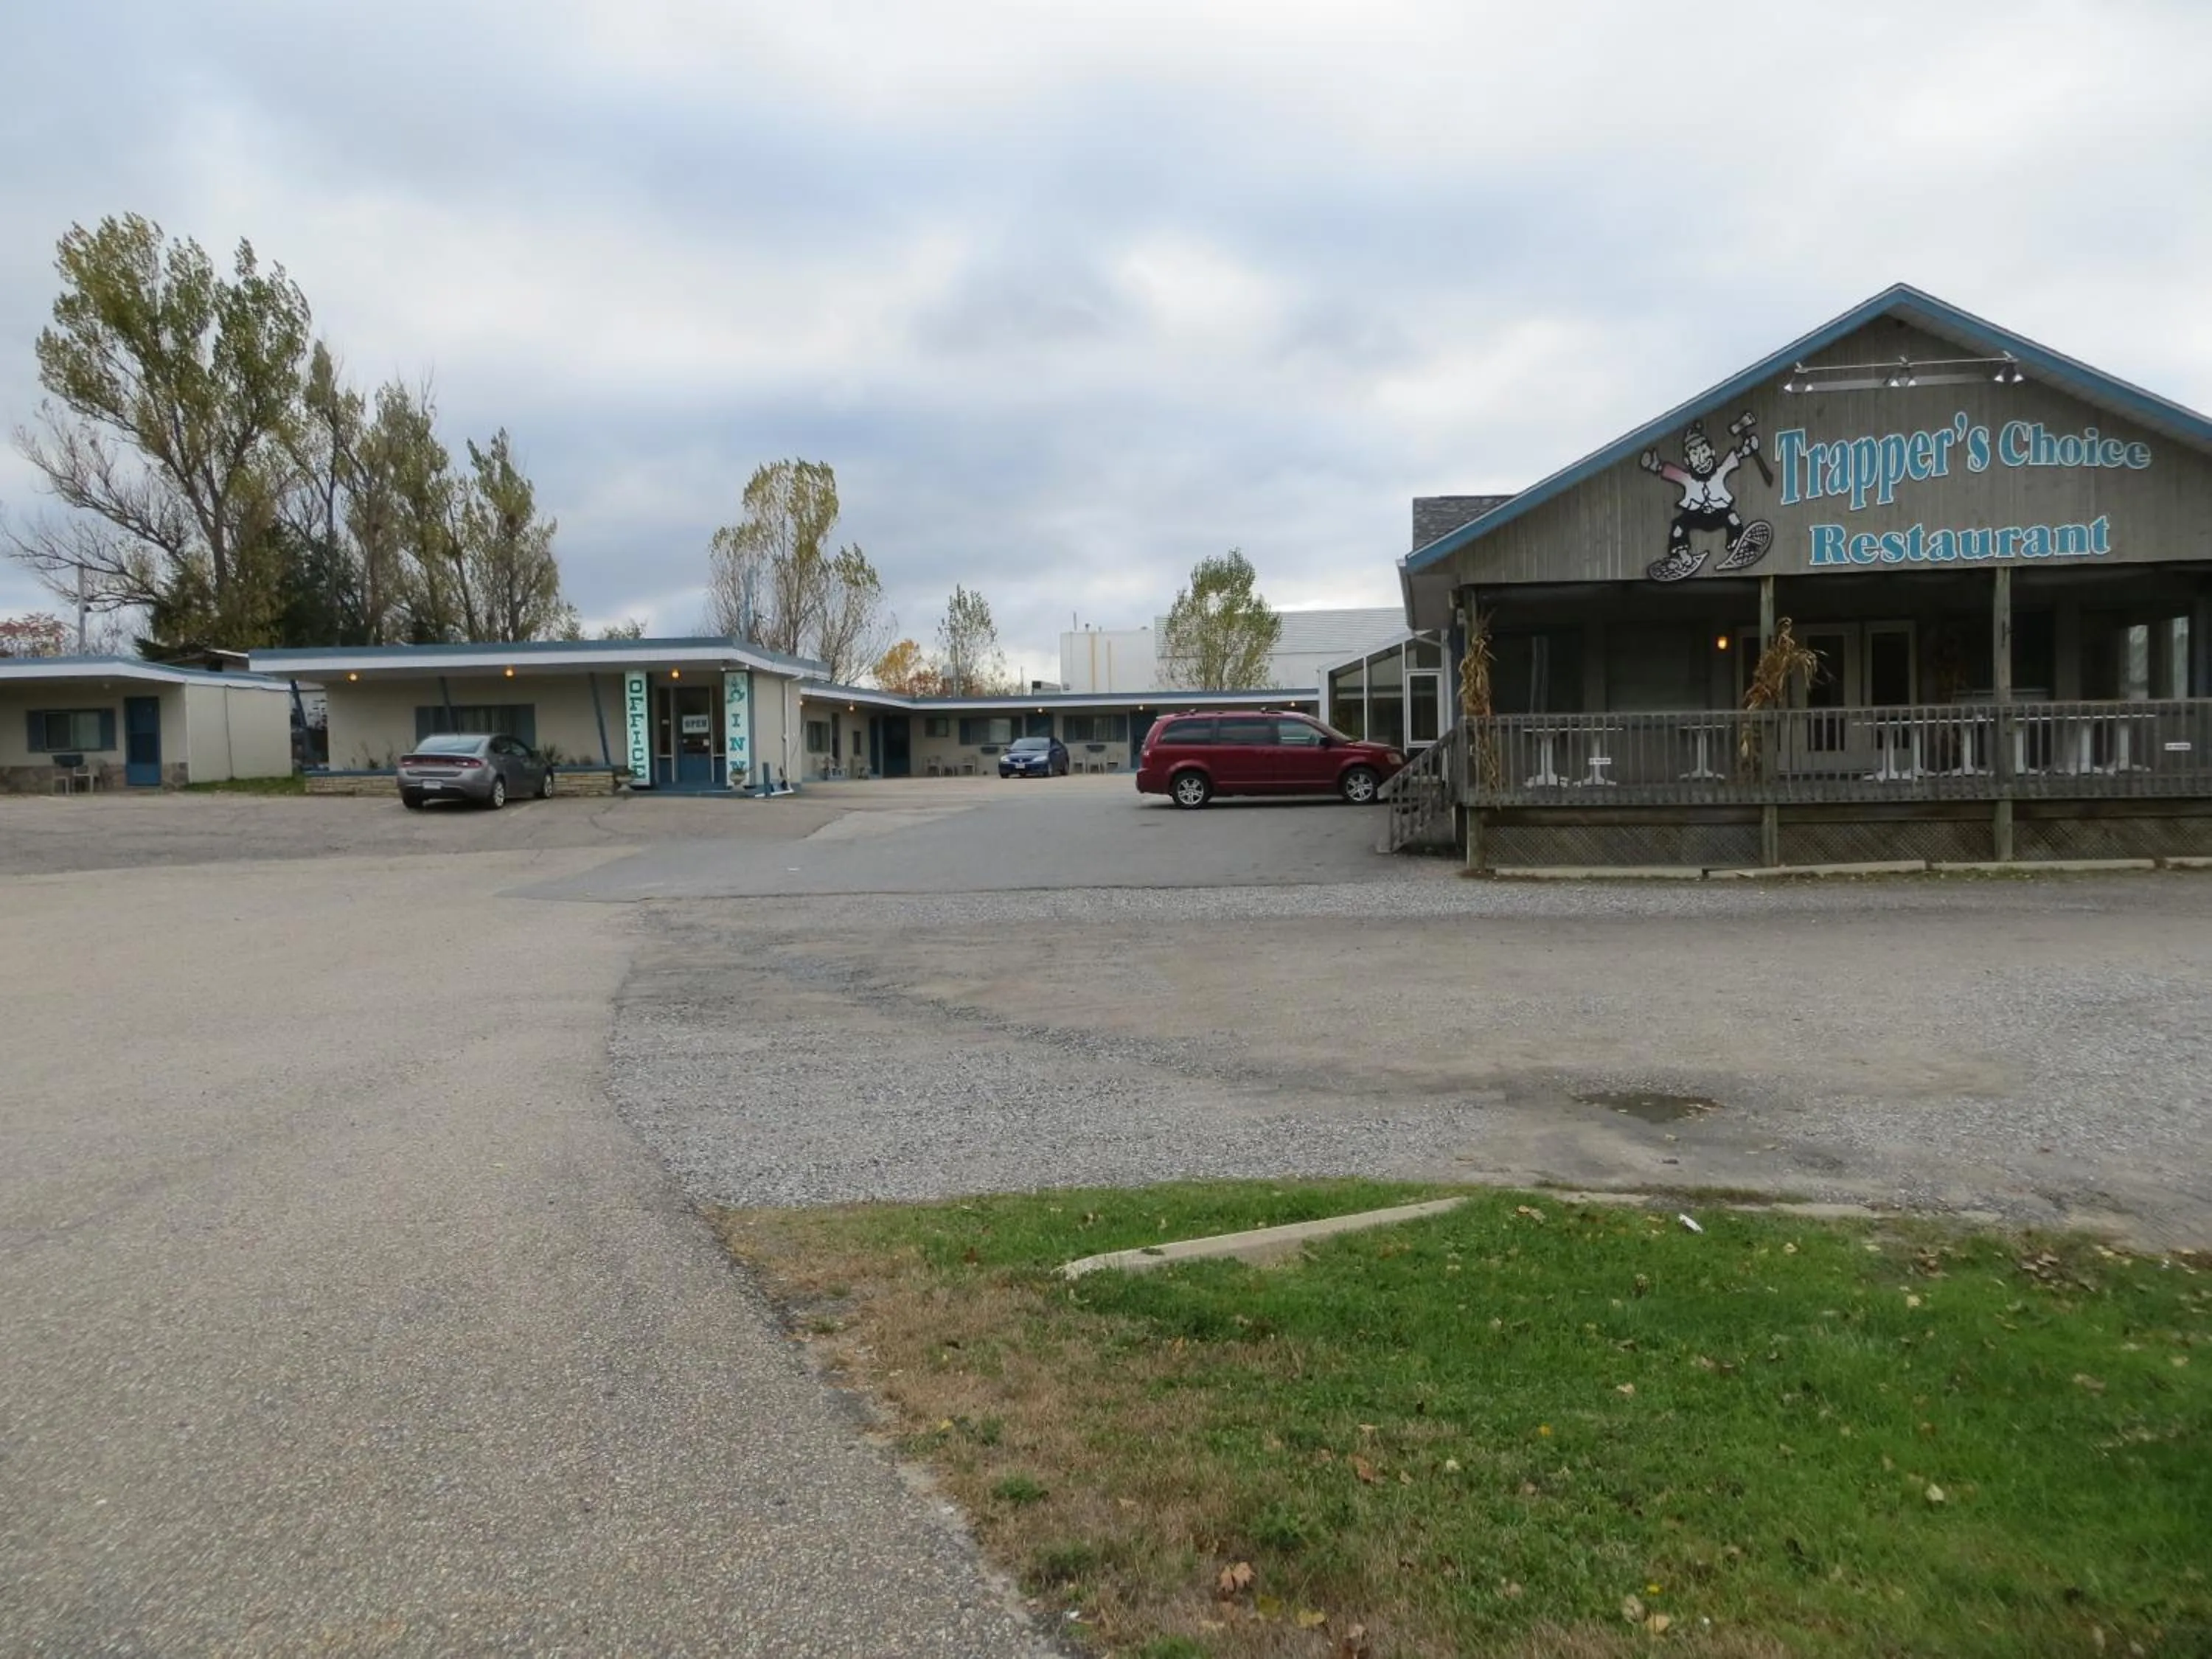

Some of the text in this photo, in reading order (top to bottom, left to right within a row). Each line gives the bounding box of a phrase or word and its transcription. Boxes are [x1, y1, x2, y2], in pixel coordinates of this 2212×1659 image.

[1775, 411, 2152, 510] Trapper's Choice
[1809, 515, 2111, 566] Restaurant
[629, 679, 646, 779] OFFICE
[729, 713, 746, 771] INN
